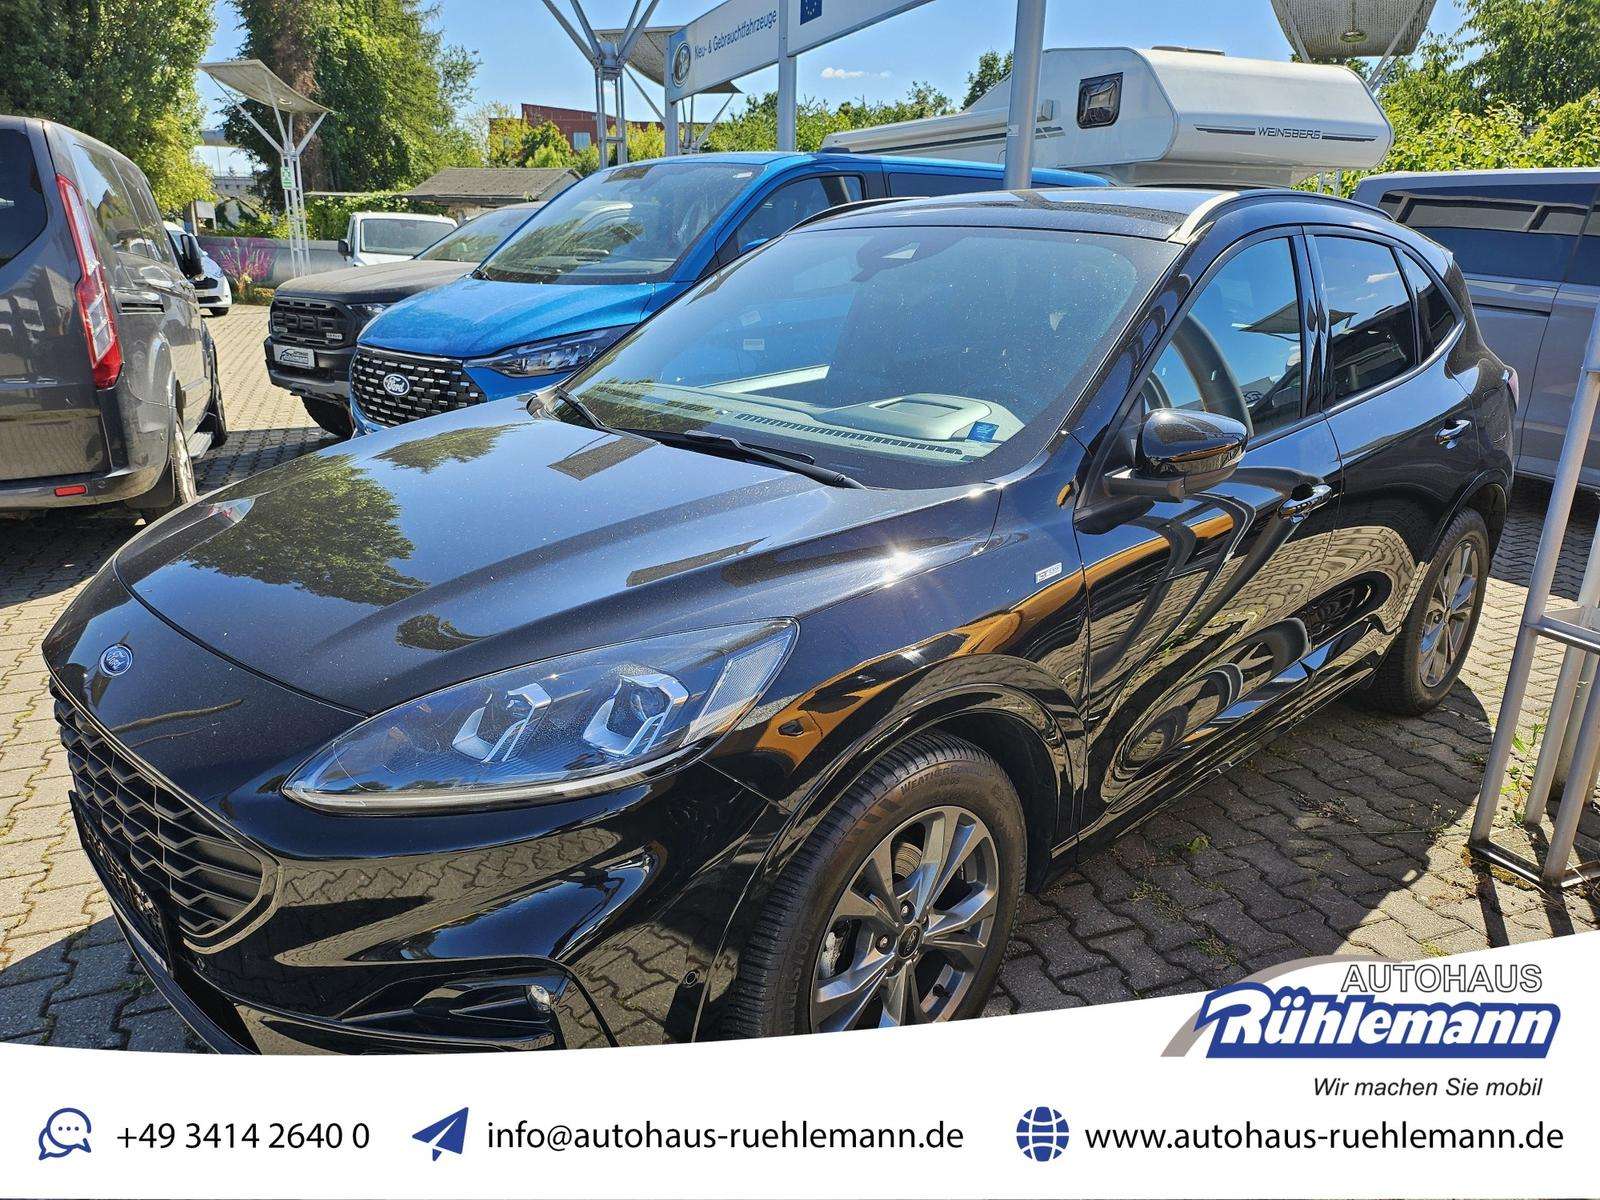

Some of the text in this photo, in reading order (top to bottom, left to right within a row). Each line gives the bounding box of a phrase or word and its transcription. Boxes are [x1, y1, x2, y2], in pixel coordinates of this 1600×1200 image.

[713, 10, 777, 51] Gebrauchtfahrzeuge
[1258, 127, 1322, 139] WEINSBERG
[385, 375, 407, 394] Ford
